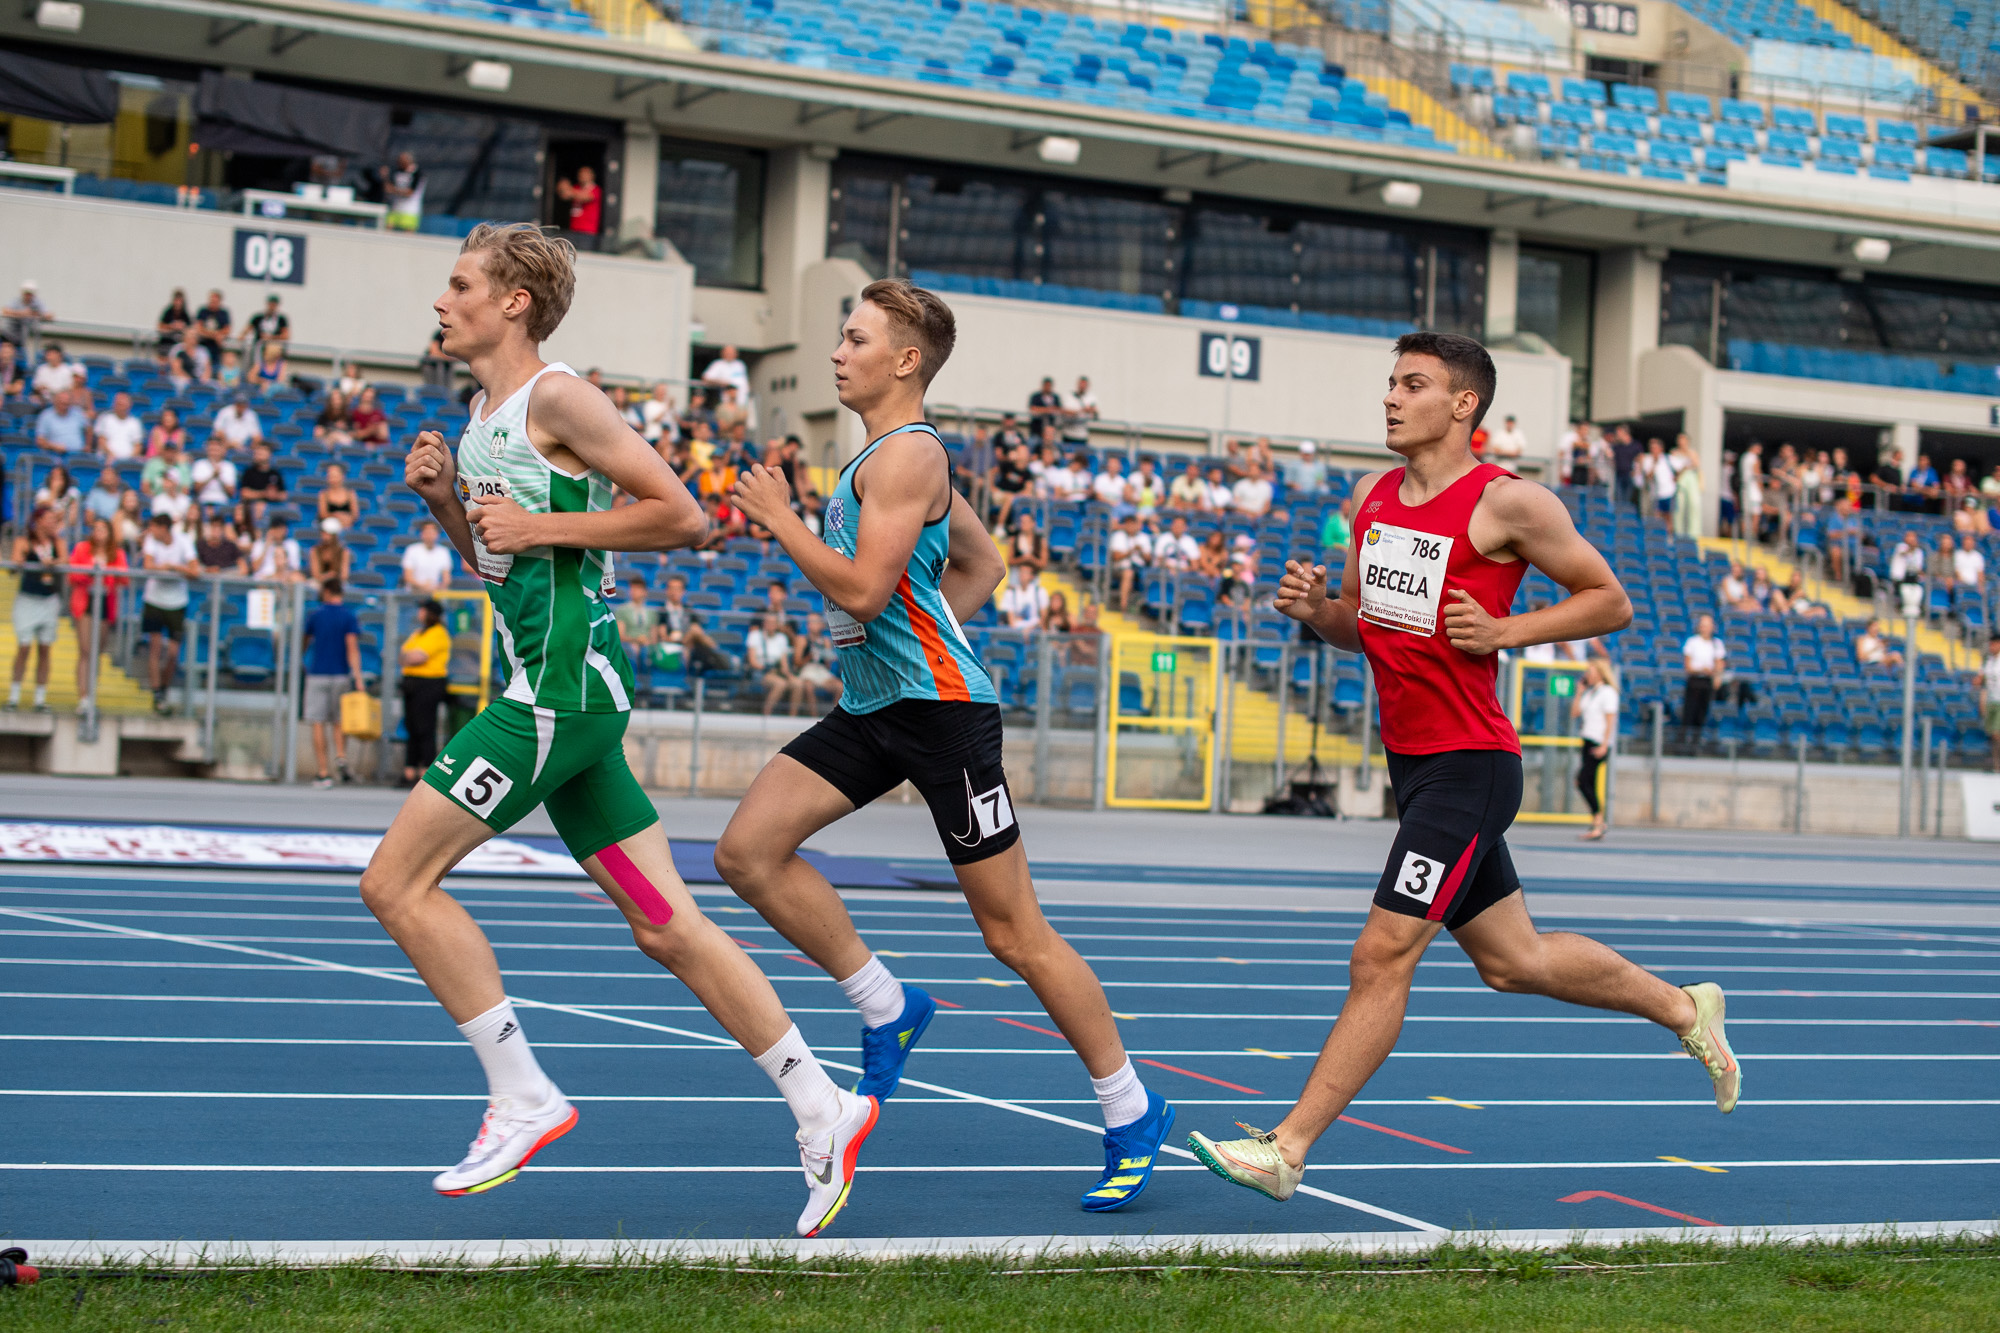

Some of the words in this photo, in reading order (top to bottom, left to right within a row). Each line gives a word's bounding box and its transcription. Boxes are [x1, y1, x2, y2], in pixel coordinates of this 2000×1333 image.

[245, 235, 293, 279] 08
[1208, 338, 1251, 376] 09
[1411, 537, 1441, 560] 786
[1366, 564, 1429, 599] BECELA
[1374, 606, 1403, 619] Mistrzostwa
[1404, 613, 1422, 623] Polski
[1422, 617, 1435, 626] U18
[1157, 654, 1172, 671] 11
[465, 767, 504, 806] 5
[980, 790, 1000, 830] 7
[1405, 859, 1432, 895] 3
[779, 1057, 801, 1078] adidas
